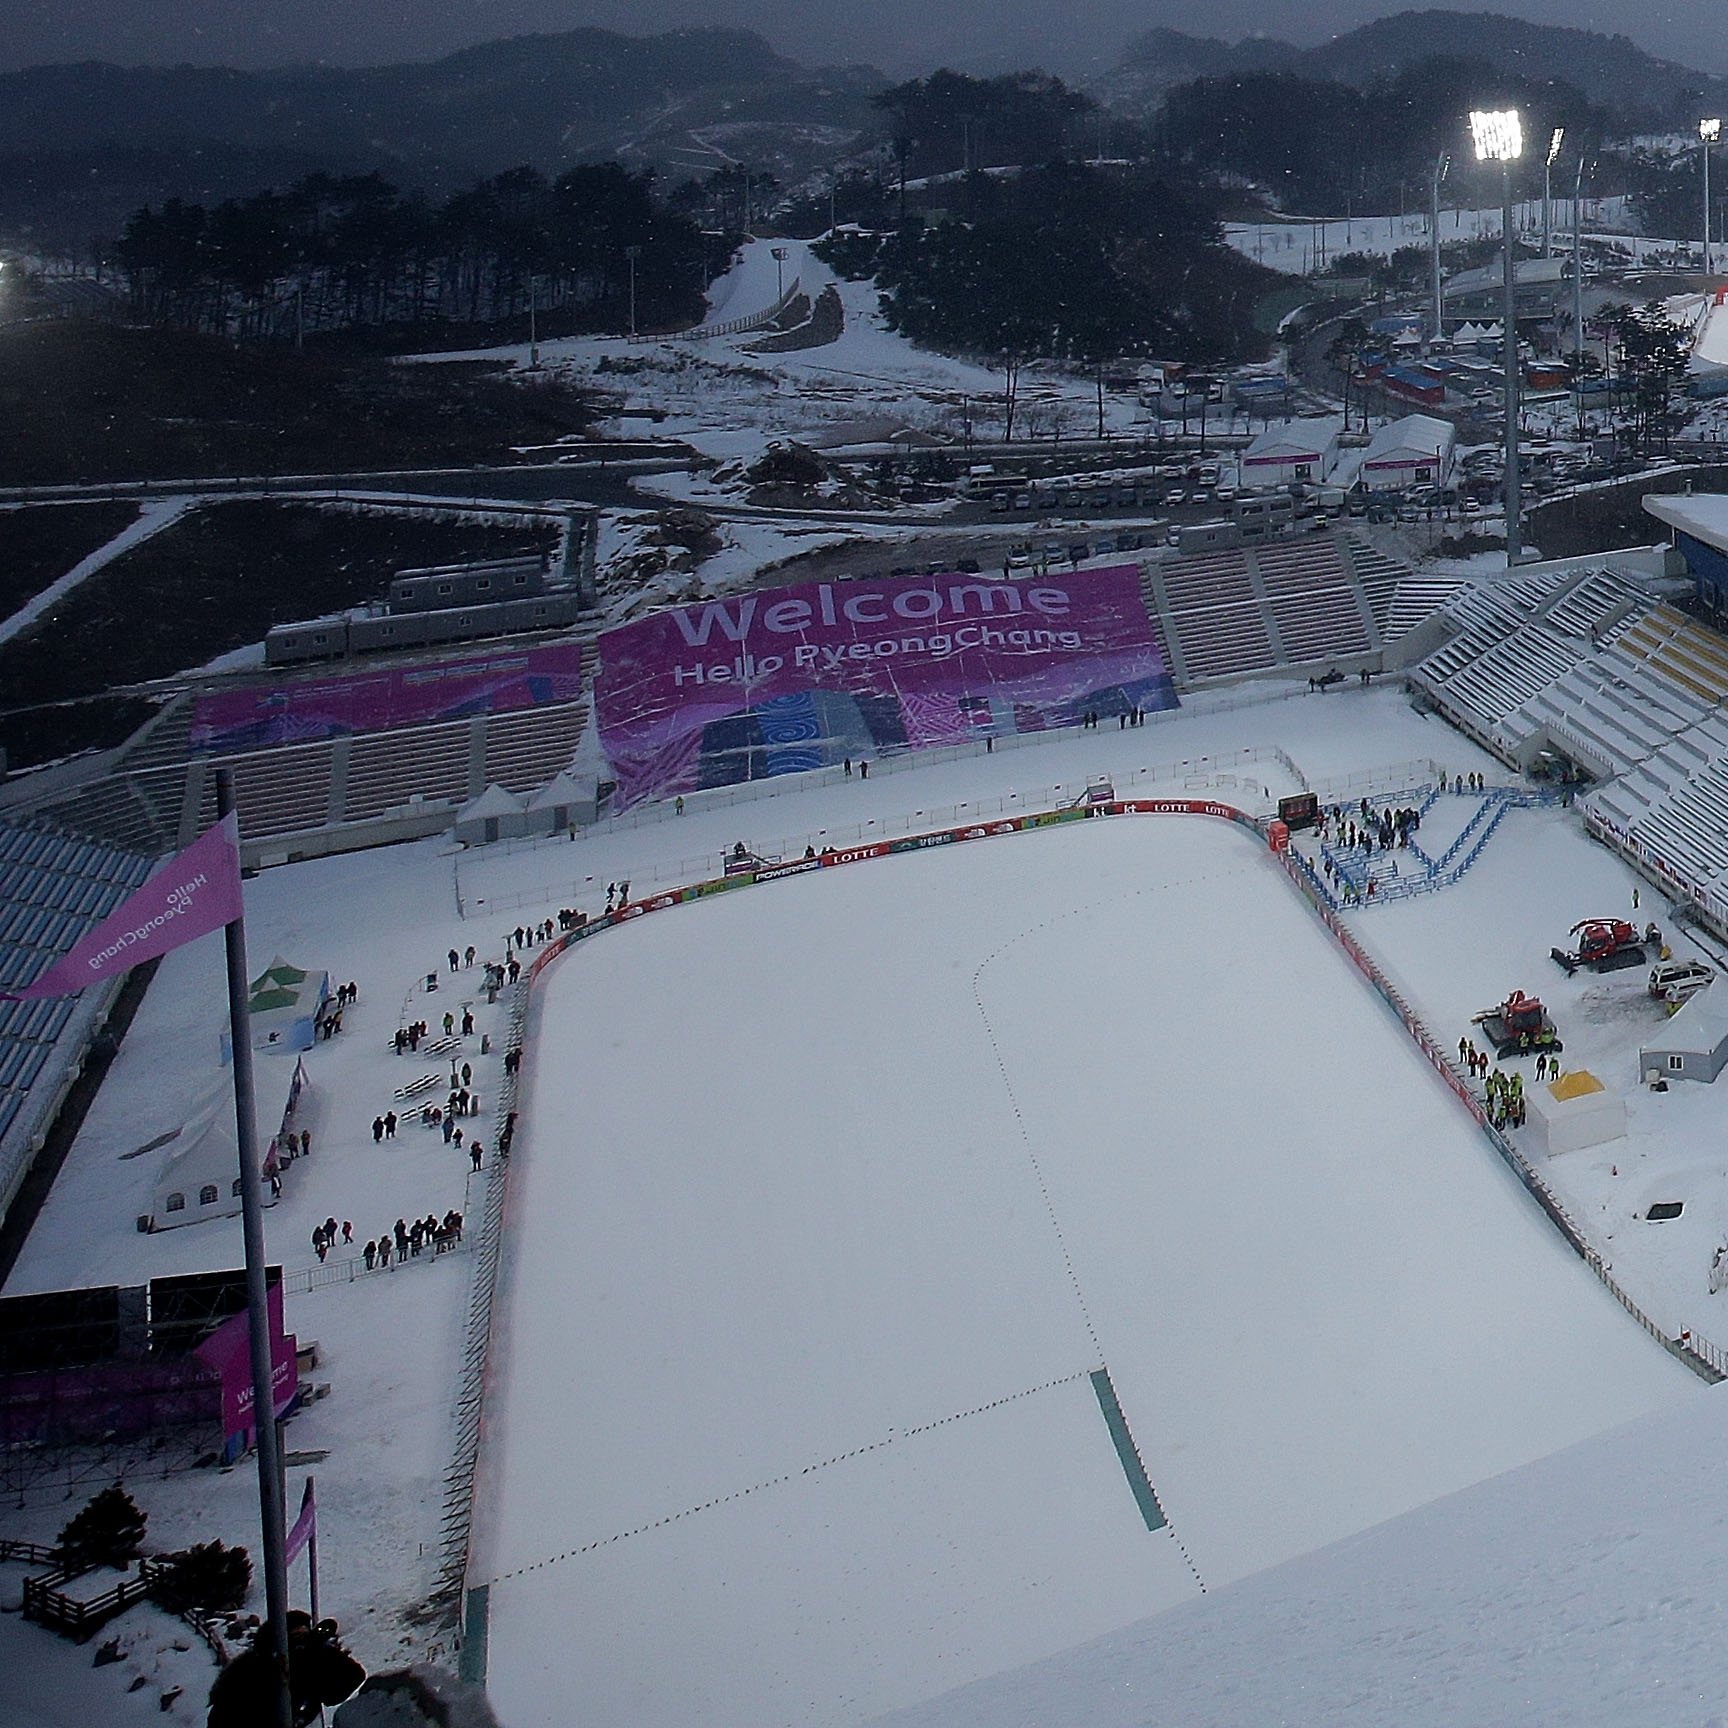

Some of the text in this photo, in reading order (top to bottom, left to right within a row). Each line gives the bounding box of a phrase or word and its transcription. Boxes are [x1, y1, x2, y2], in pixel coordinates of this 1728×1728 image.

[669, 584, 1071, 648] Welcome
[674, 626, 1082, 687] Hello PyeongChang
[1123, 803, 1137, 814] kt
[1154, 803, 1190, 813] LOTTE
[833, 847, 880, 864] LOTTE
[237, 1360, 289, 1404] Weme
